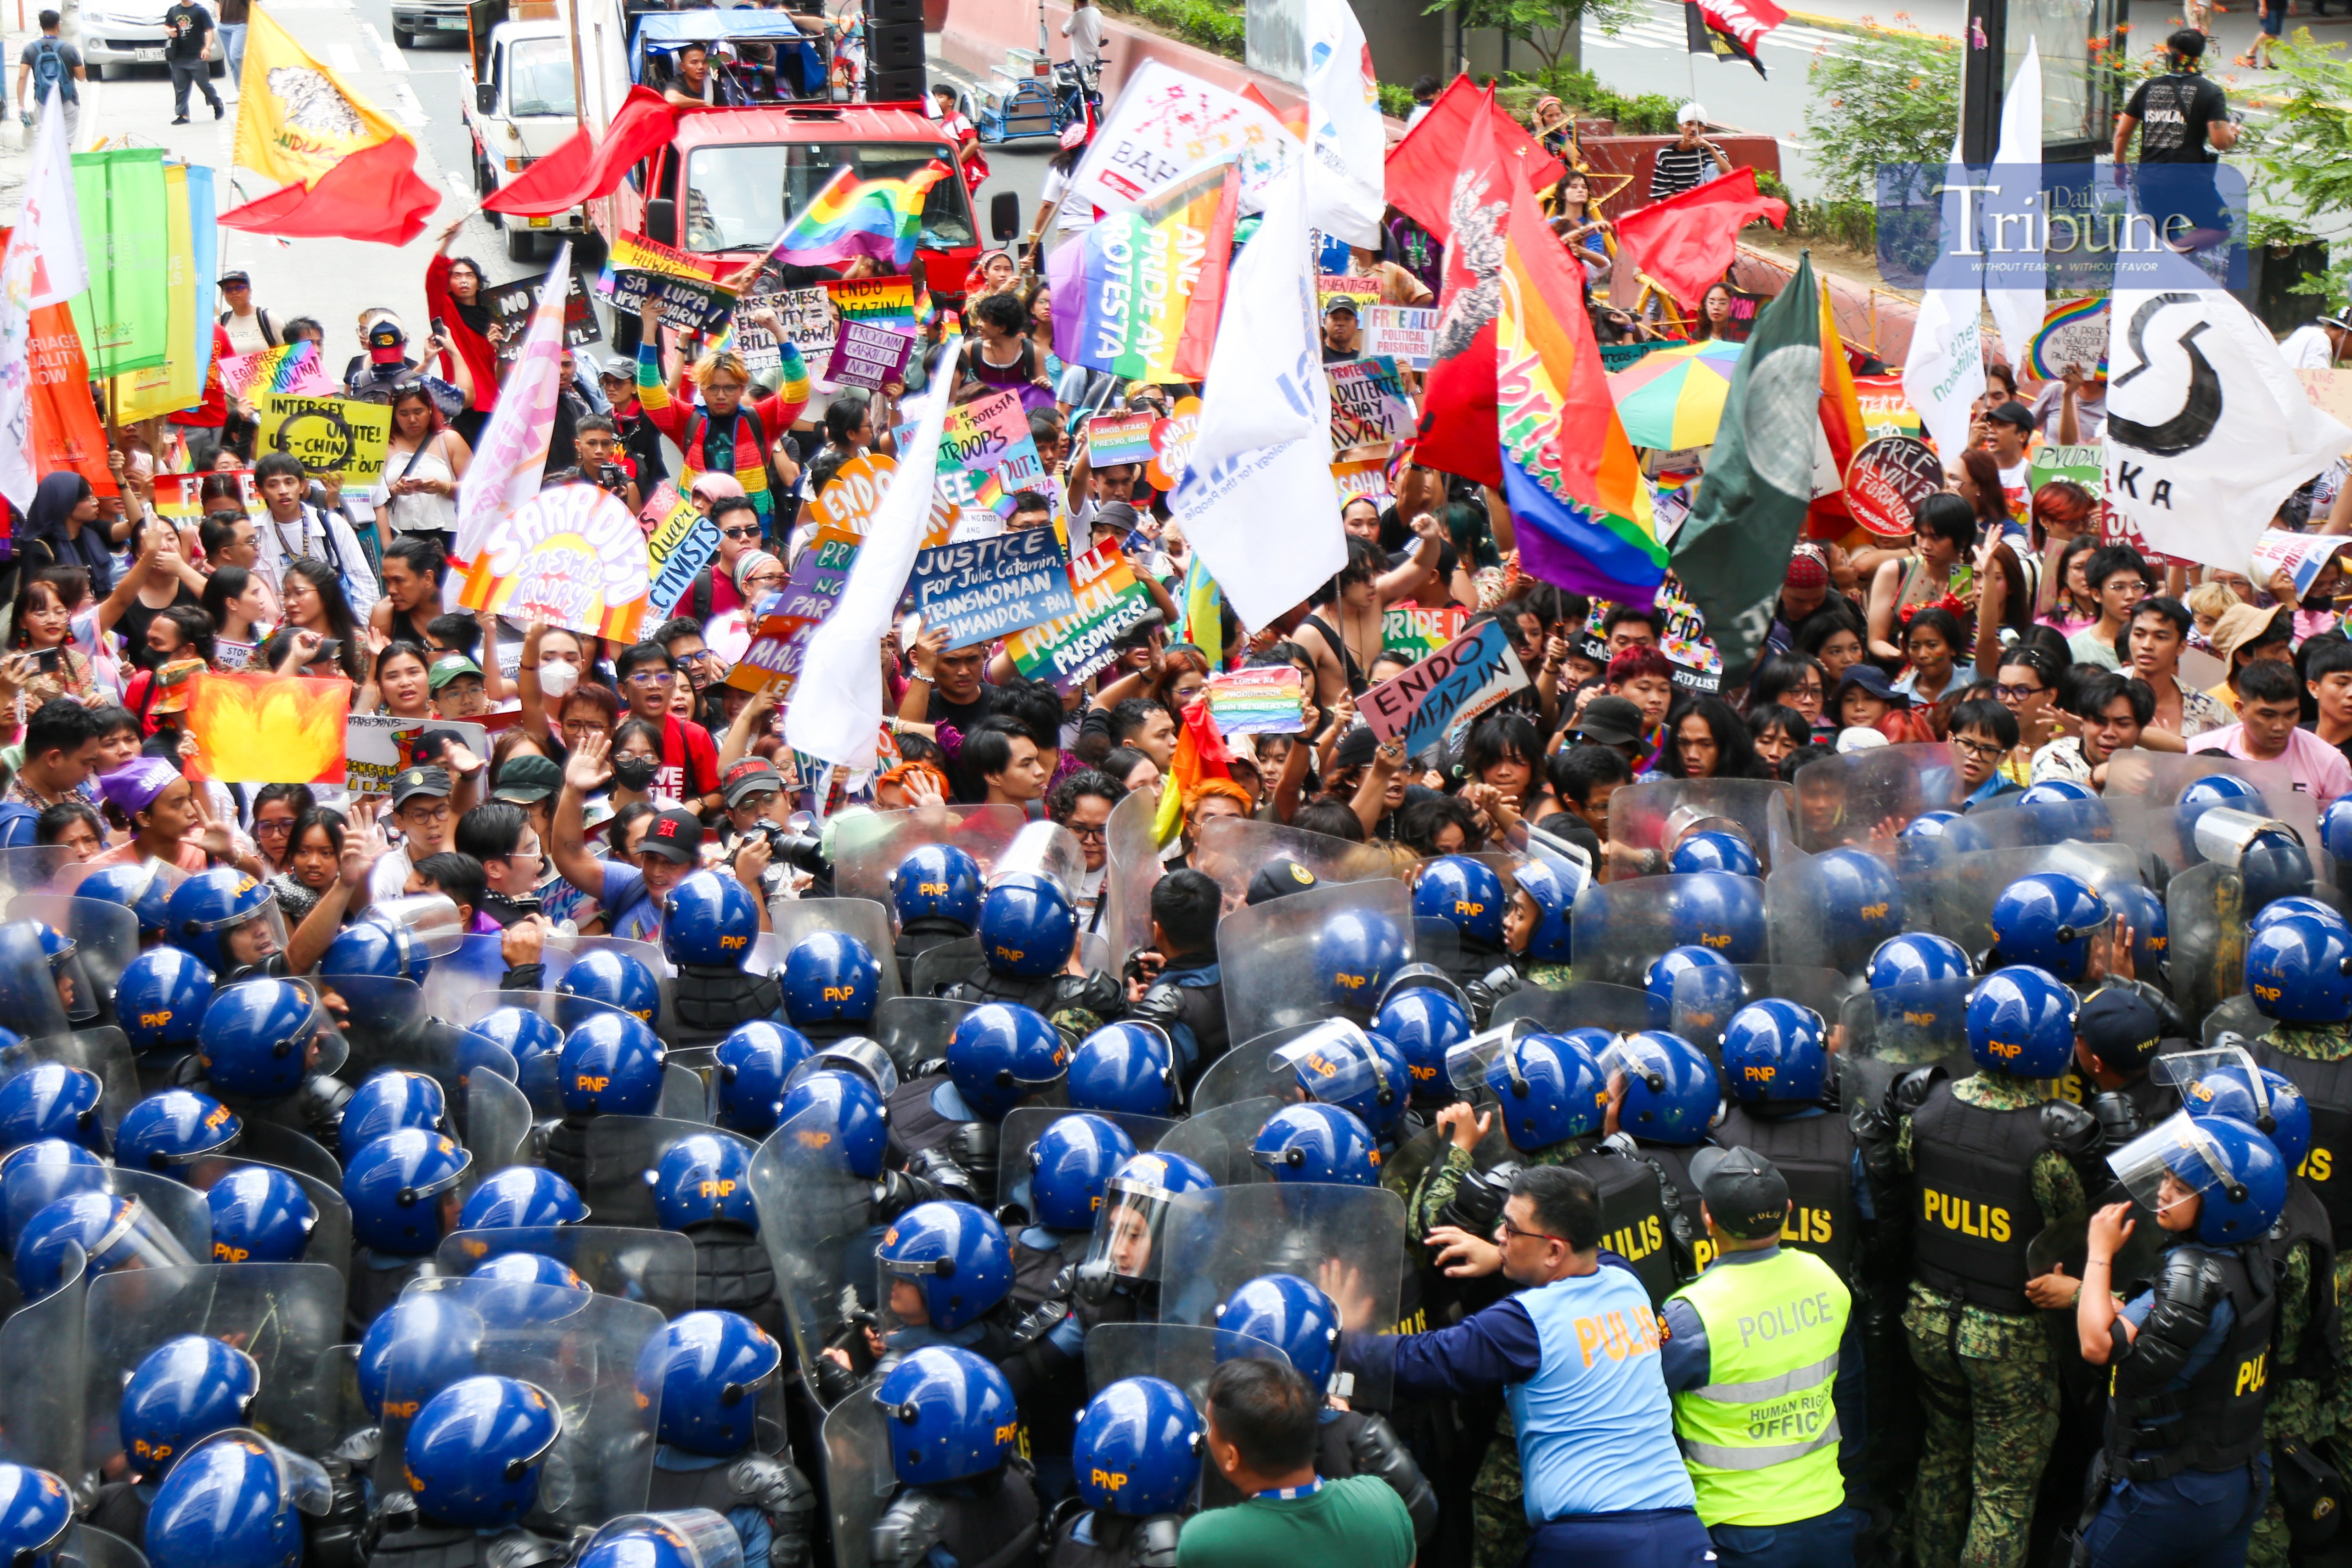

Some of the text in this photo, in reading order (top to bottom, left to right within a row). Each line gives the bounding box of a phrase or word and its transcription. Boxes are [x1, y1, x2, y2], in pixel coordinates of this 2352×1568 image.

[153, 51, 165, 59] 595
[2144, 109, 2186, 123] ISKOLA
[630, 236, 698, 272] MAKIBEKI
[624, 275, 648, 294] SA
[663, 283, 710, 312] LUPA
[838, 281, 883, 298] ENDO
[1135, 227, 1170, 368] PRIDE AY
[500, 291, 530, 317] NO
[735, 290, 822, 313] PASS SOGIESC
[840, 294, 906, 320] AFAZIN!
[1372, 309, 1437, 330] FREE ALL
[1382, 330, 1425, 343] POLITICAL
[2052, 337, 2060, 345] IN
[2063, 326, 2105, 337] NO PRIDE
[243, 349, 281, 365] SOGIESC
[1377, 342, 1429, 355] PRISONERS!
[2051, 352, 2100, 363] PALESTINE
[2066, 346, 2088, 355] FREE
[232, 355, 304, 378] EQUALITY BILL
[270, 367, 302, 391] NOW
[301, 356, 321, 377] NA!
[1331, 360, 1384, 379] PROTESTA
[1334, 376, 1403, 404] DUTERTE
[271, 399, 346, 419] INTERSEX
[965, 393, 1016, 432] PROTESTA
[1095, 422, 1148, 436] SAHOD, ITAAS!
[938, 425, 1008, 465] TROOPS
[1876, 438, 1938, 478] FREE
[1338, 470, 1385, 495] SAHO
[1855, 452, 1918, 496] ALVIN
[982, 514, 997, 523] DIOS
[485, 483, 599, 578] SARA
[649, 506, 696, 564] Queer
[649, 518, 721, 611] CTIVISTS
[917, 530, 1045, 576] JUSTICE
[958, 554, 1061, 589] Julie Catamin.
[1074, 548, 1115, 587] ALL
[520, 575, 595, 621] AWAY!
[813, 579, 845, 596] NG
[921, 572, 1052, 624] TRANSWOMAN
[499, 604, 568, 629] Kaliksan
[791, 596, 832, 619] PAR
[1022, 584, 1127, 661] POLITICAL
[1054, 594, 1148, 675] PRISONERS!
[227, 646, 248, 658] STOP
[1374, 636, 1485, 718] ENDO
[1213, 702, 1299, 712] HINDI IMPORTASYON
[1389, 651, 1512, 740] WAFAZIN
[921, 883, 950, 897] PNP
[1455, 900, 1485, 917] PNP
[1860, 902, 1888, 921] PNP
[721, 935, 747, 950] PNP
[996, 945, 1025, 962] PNP
[1336, 972, 1366, 989] PNP
[825, 986, 855, 1002] PNP
[2254, 983, 2282, 1003] PNP
[141, 1011, 173, 1029] PNP
[1903, 1011, 1936, 1028] PNP
[1988, 1040, 2023, 1060] PNP
[1305, 1052, 1338, 1079] PULIS
[1744, 1066, 1777, 1082] PNP
[578, 1075, 610, 1092] PNP
[701, 1180, 737, 1199] PNP
[1780, 1208, 1833, 1244] LIS
[1924, 1188, 2011, 1243] PULIS
[214, 1242, 249, 1263] PNP
[1738, 1292, 1834, 1348] POLICE
[1572, 1304, 1661, 1369] PULIS
[383, 1402, 420, 1419] PNP
[1750, 1399, 1797, 1423] HUMAN
[995, 1421, 1018, 1446] PNP
[1748, 1408, 1826, 1441] OFFIC
[1092, 1468, 1128, 1492] PNP
